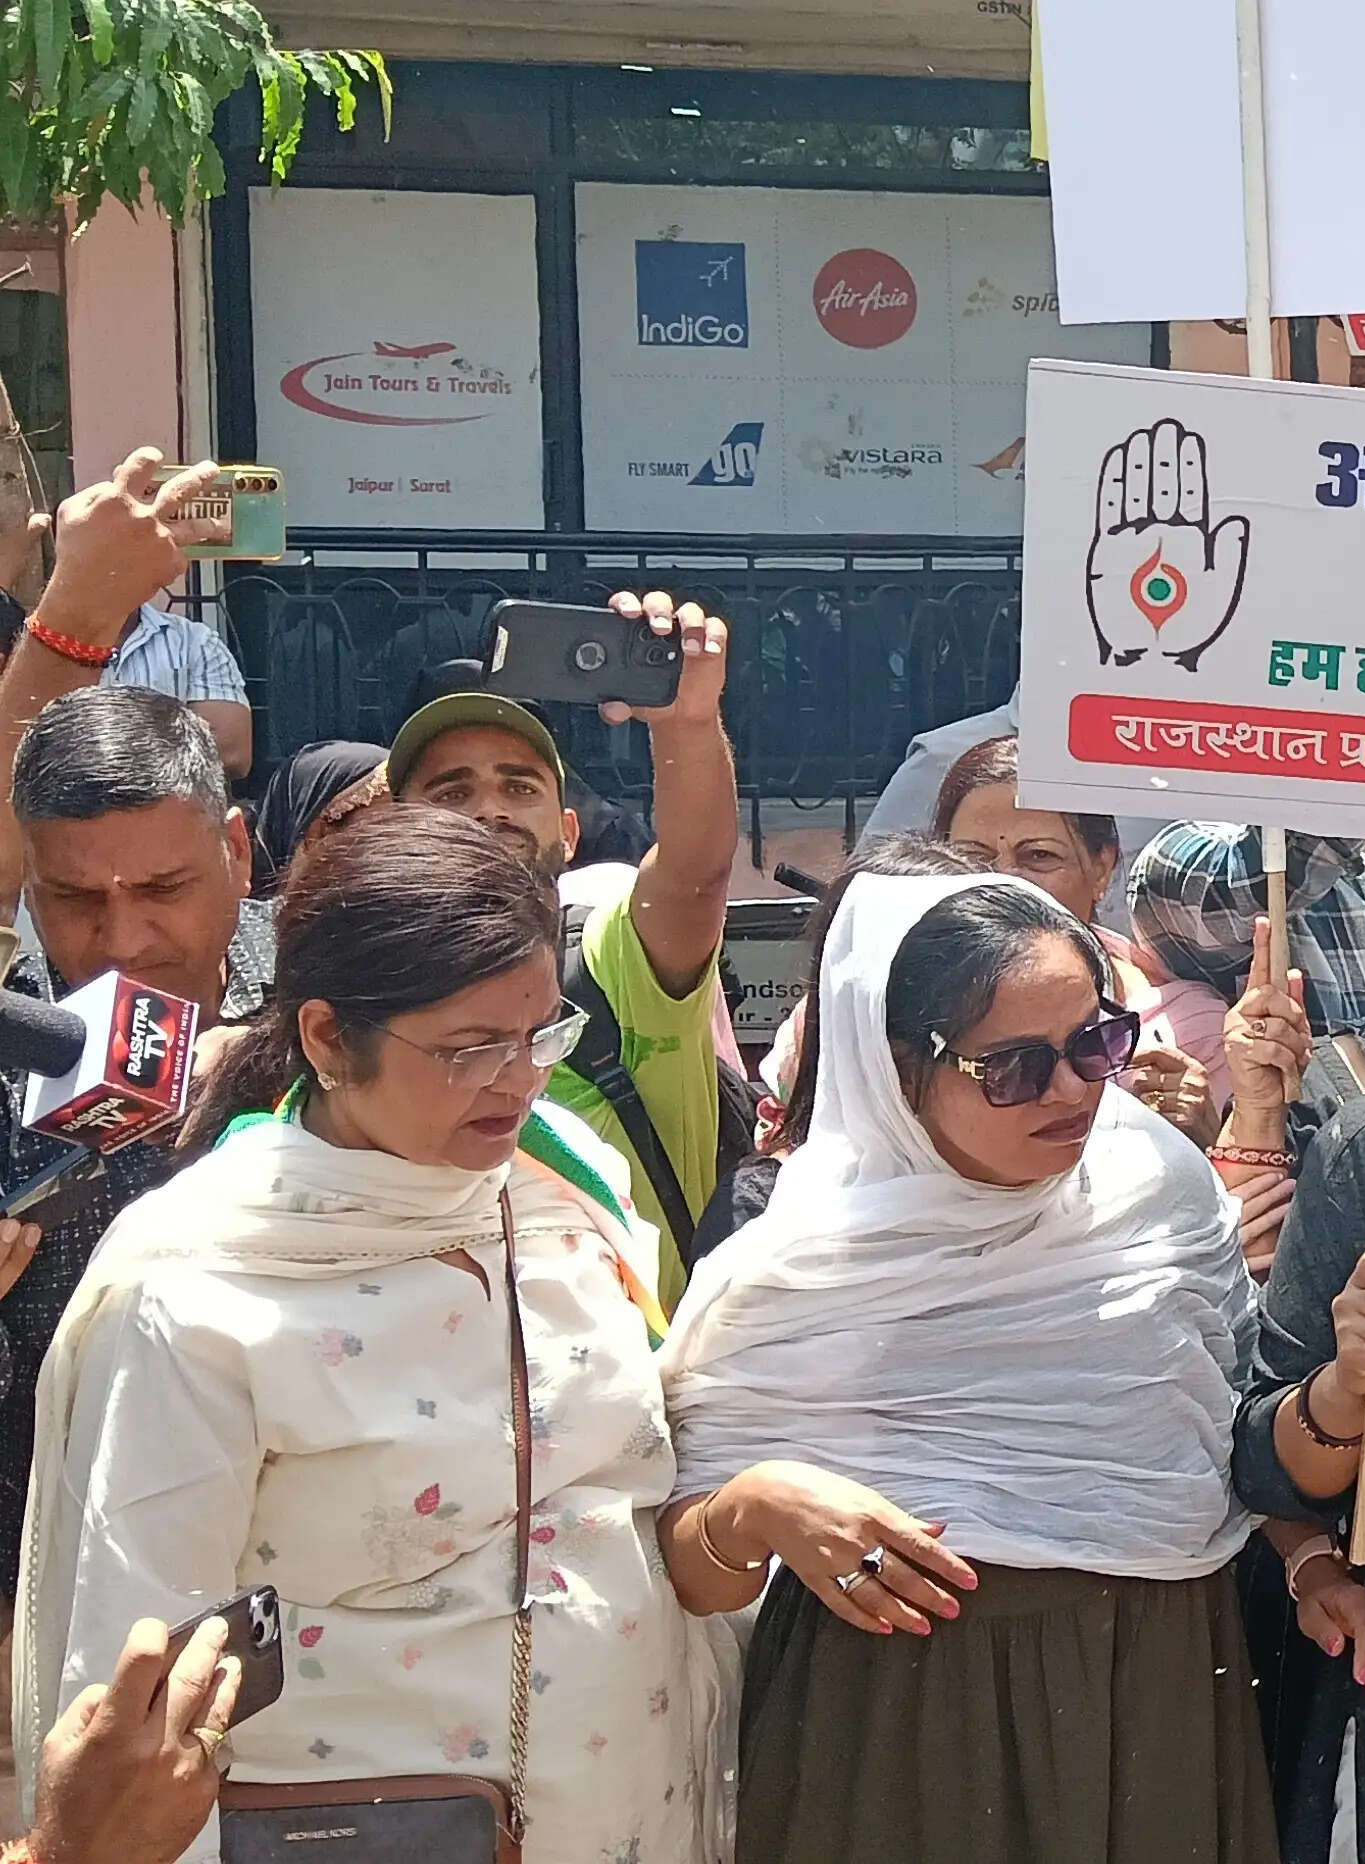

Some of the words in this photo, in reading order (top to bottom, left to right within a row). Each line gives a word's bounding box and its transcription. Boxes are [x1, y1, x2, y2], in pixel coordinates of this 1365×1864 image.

[641, 314, 744, 345] IndiGo
[324, 374, 362, 393] Jain
[369, 374, 419, 392] Tours
[426, 376, 441, 392] &
[448, 377, 512, 394] Travels
[628, 463, 647, 477] FLY
[649, 462, 689, 478] SMART
[347, 478, 394, 494] Jaipur
[410, 478, 452, 493] Surat
[1268, 639, 1345, 693] हम
[1113, 711, 1327, 766] राजस्थान
[744, 980, 804, 999] ndso
[182, 1002, 191, 1030] INDIA
[126, 997, 152, 1077] RASHTRA
[144, 1021, 169, 1061] TV
[178, 1031, 187, 1047] OF
[174, 1048, 184, 1084] VOICE
[169, 1084, 180, 1104] THE
[62, 1097, 126, 1133] RASHTRA
[91, 1110, 128, 1130] TV
